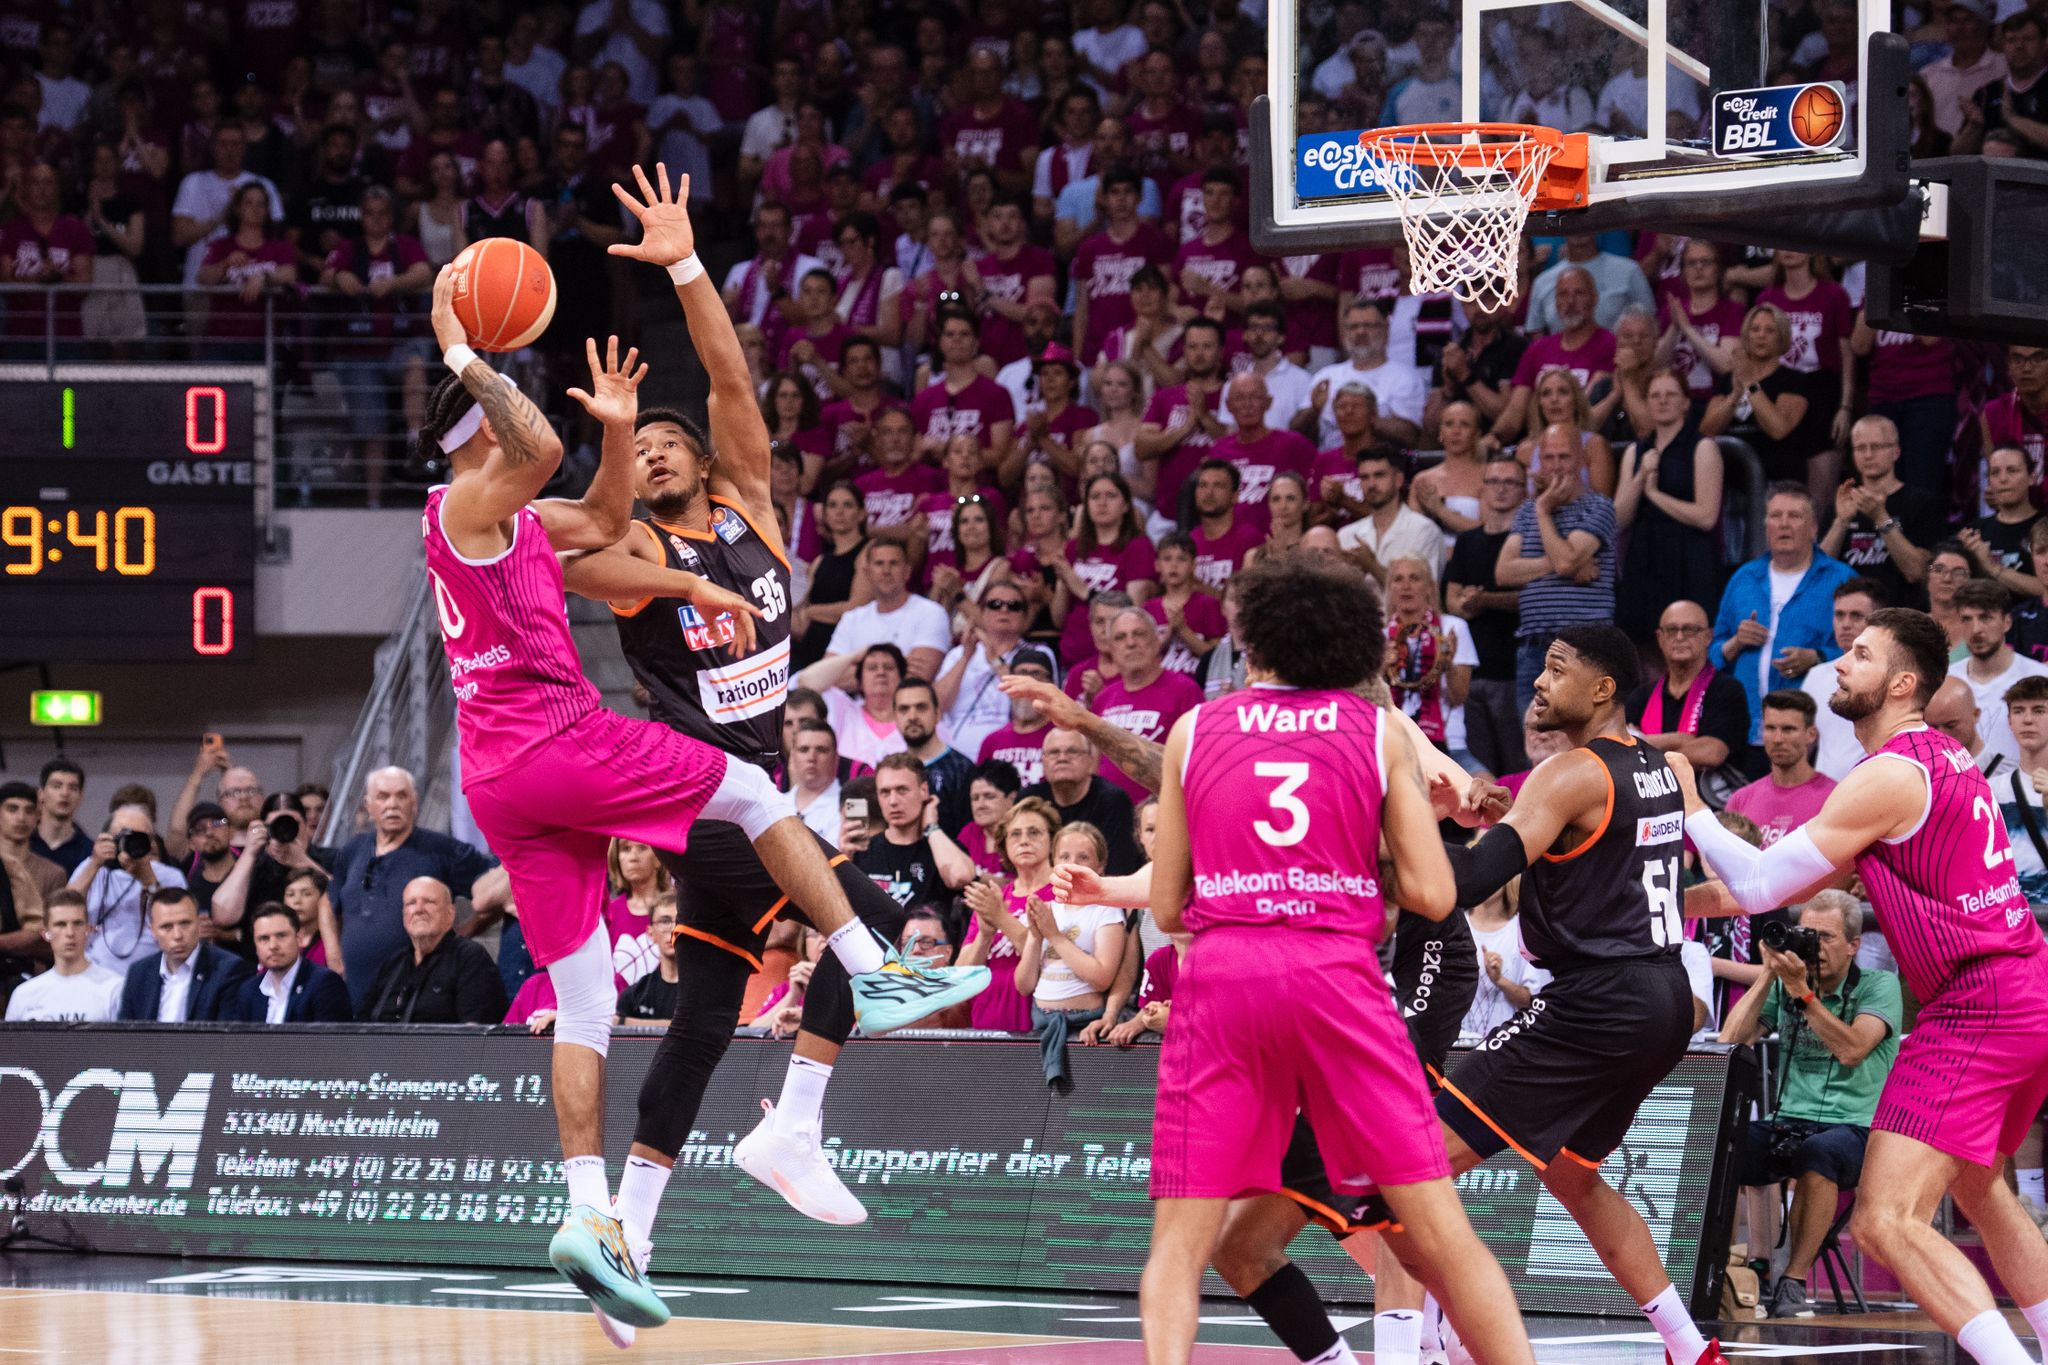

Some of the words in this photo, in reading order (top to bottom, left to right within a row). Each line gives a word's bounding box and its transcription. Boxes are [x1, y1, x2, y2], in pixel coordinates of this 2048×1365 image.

[1723, 121, 1777, 150] BBL
[1739, 106, 1778, 121] Credit
[63, 387, 75, 449] 1
[186, 386, 226, 454] 0
[1, 506, 156, 576] 9:40
[193, 586, 233, 655] 0
[751, 568, 786, 623] 35
[717, 664, 789, 705] ratiophar
[1237, 701, 1338, 733] Ward
[1253, 762, 1310, 846] 3
[1194, 868, 1286, 898] Telekom
[1287, 866, 1378, 898] Baskets
[1256, 898, 1316, 916] Bonn
[1642, 857, 1683, 948] 51
[822, 1135, 999, 1185] Supporter
[1005, 1138, 1072, 1178] der
[1083, 1142, 1152, 1180] Tele
